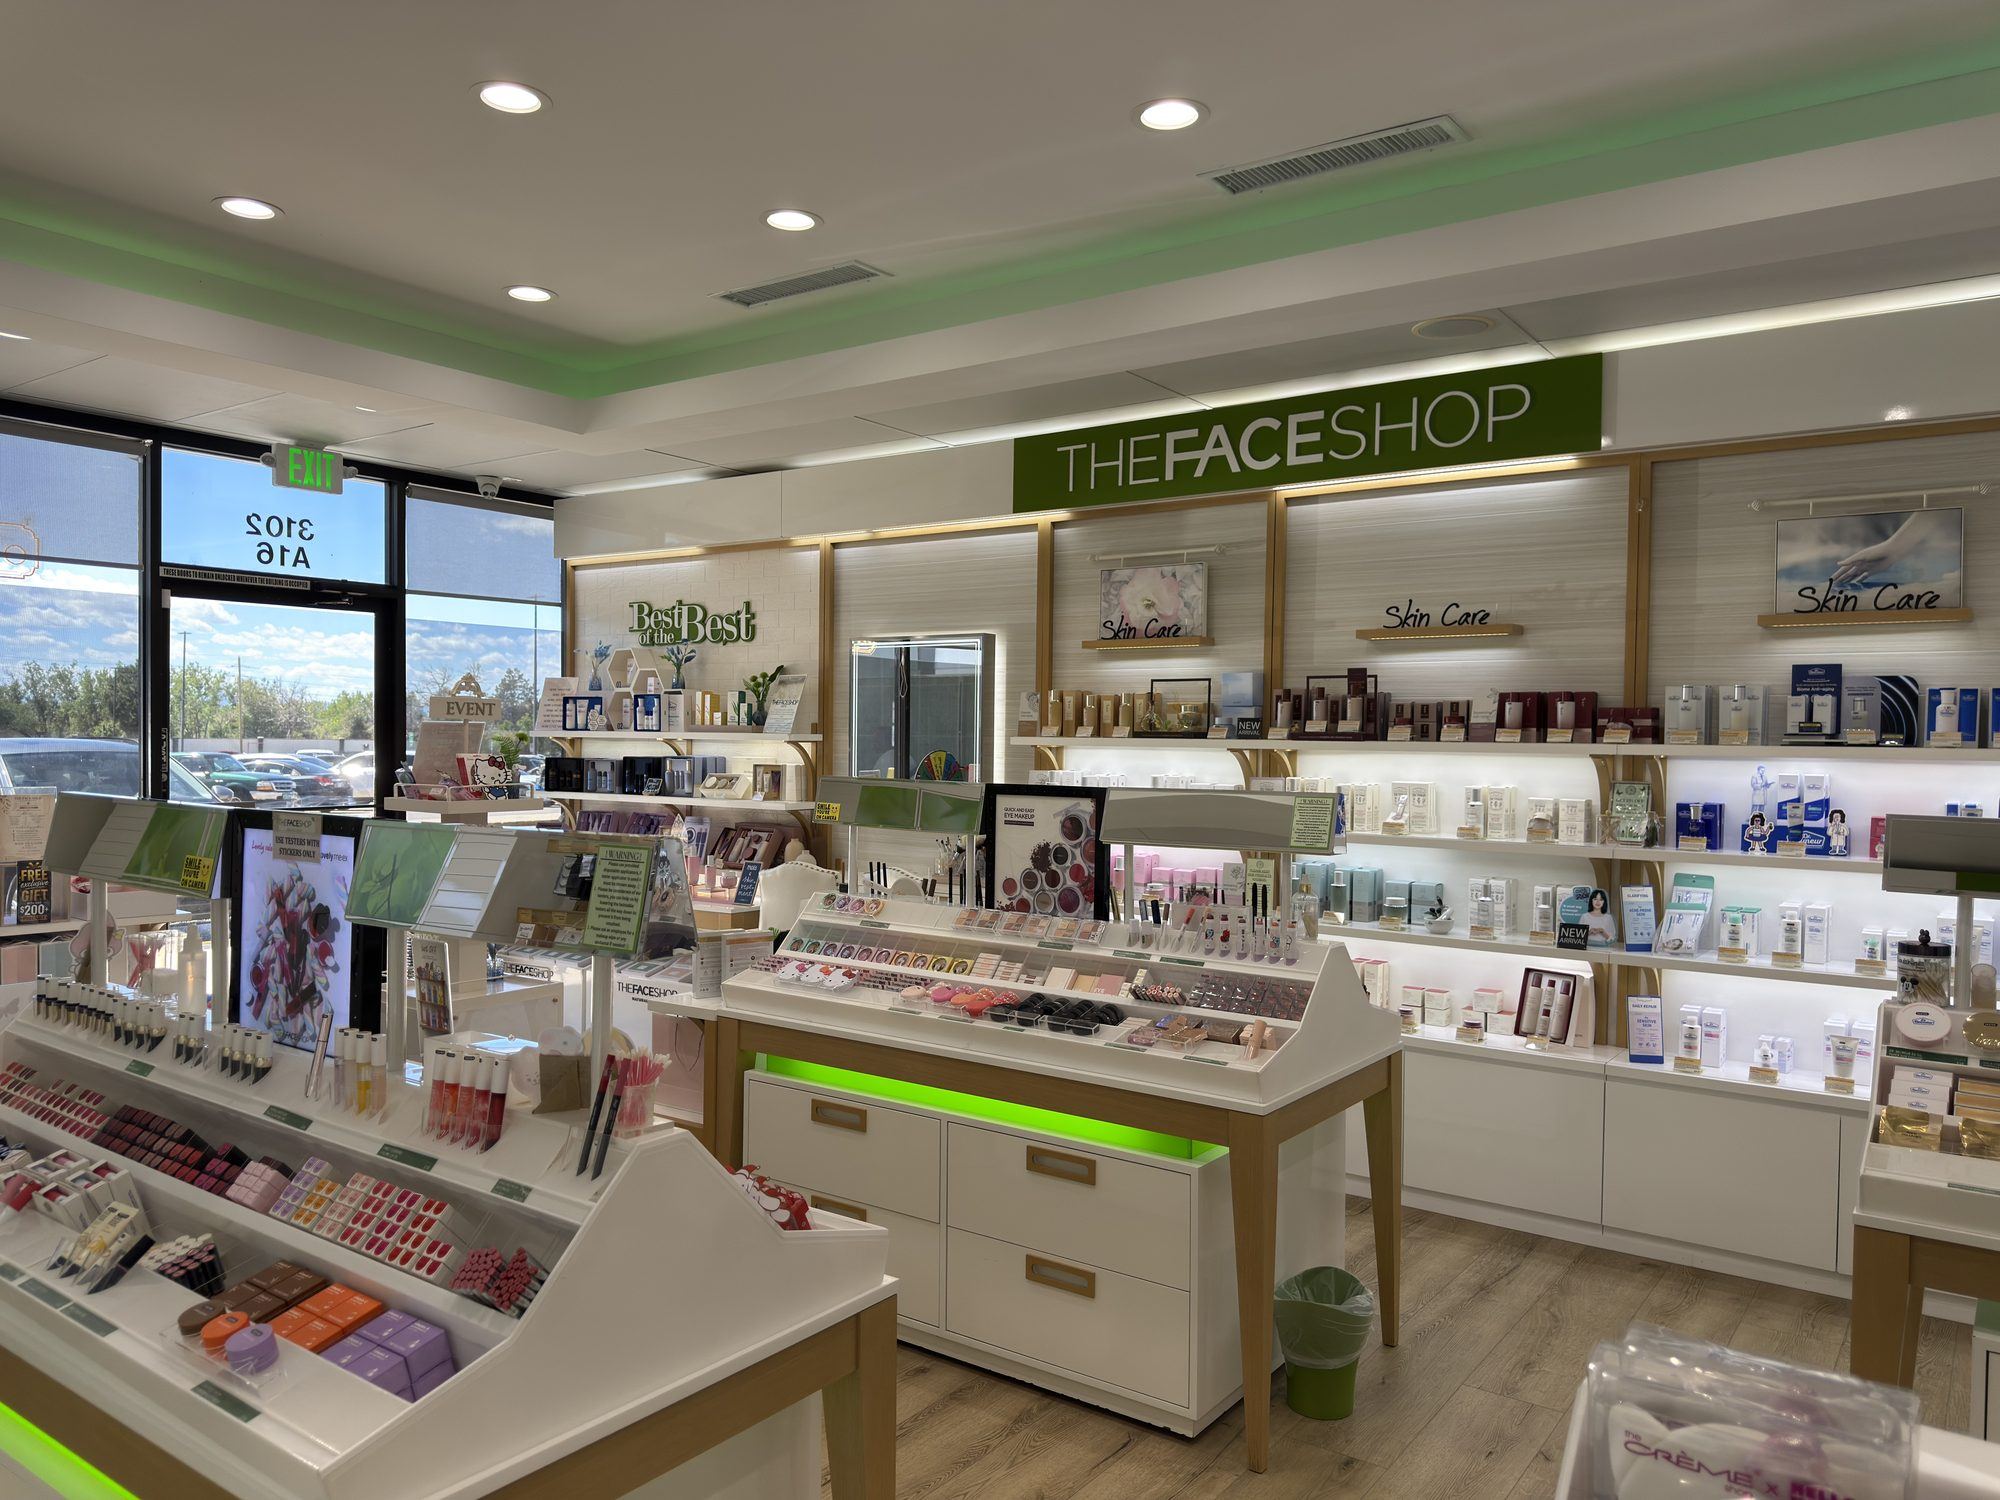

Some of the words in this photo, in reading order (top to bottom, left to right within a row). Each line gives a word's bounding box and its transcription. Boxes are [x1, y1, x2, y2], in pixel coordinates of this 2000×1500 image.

[288, 447, 335, 491] EXIT
[163, 567, 177, 576] THESE
[177, 569, 192, 577] DOORS
[192, 570, 198, 578] TO
[199, 571, 214, 580] REMAIN
[214, 572, 236, 582] UNLOCKED
[236, 574, 257, 584] WHENEVER
[257, 577, 265, 585] THE
[265, 577, 284, 586] BUILDING
[288, 580, 308, 589] OCCUPIED
[1794, 577, 1858, 614] Skin
[1873, 582, 1941, 611] Care
[629, 599, 682, 632] Best
[1383, 598, 1431, 629] Skin
[1441, 602, 1491, 627] Care
[680, 600, 755, 644] Best
[1101, 615, 1137, 640] Skin
[1143, 617, 1182, 639] Care
[638, 628, 652, 645] of
[653, 628, 675, 644] the
[446, 701, 496, 716] EVENT
[1238, 721, 1261, 730] NEW
[275, 835, 285, 845] USE
[284, 836, 306, 847] TESTERS
[306, 839, 320, 849] WITH
[279, 846, 303, 858] STICKERS
[301, 849, 316, 859] ONLY
[185, 857, 201, 869] SMILE
[20, 869, 48, 881] FREE
[183, 868, 200, 879] YOU'RE
[20, 879, 49, 889] exclusive
[181, 879, 188, 888] ON
[187, 879, 206, 890] CAMERA
[21, 889, 48, 901] GIFT
[20, 904, 49, 915] $200+
[1560, 927, 1587, 938] NEW
[1559, 937, 1586, 945] ARRIVAL
[1624, 1440, 1753, 1487] CRÈME
